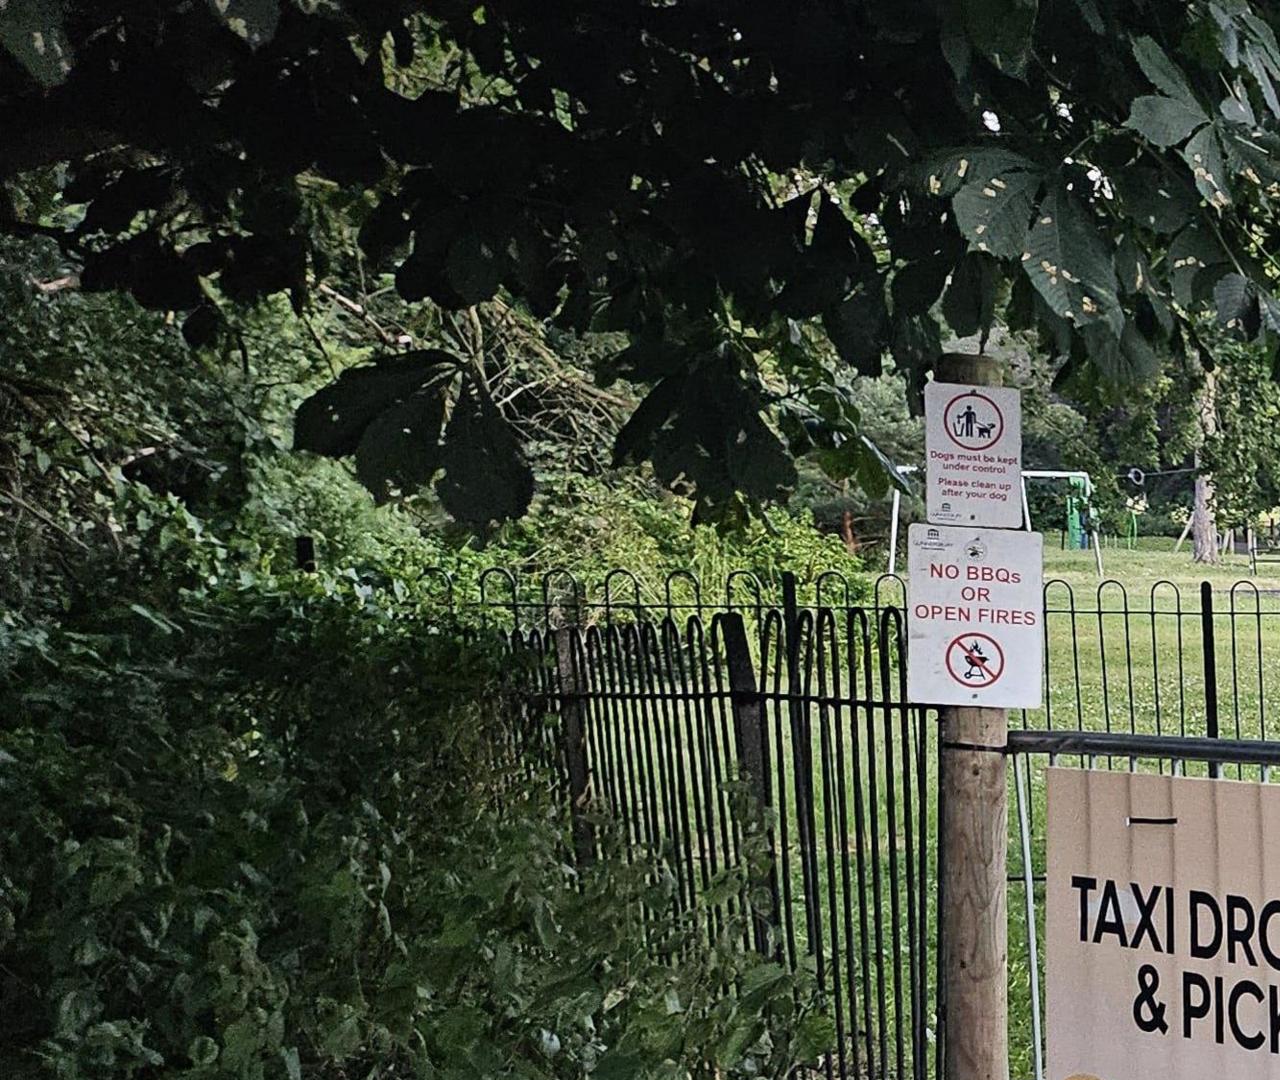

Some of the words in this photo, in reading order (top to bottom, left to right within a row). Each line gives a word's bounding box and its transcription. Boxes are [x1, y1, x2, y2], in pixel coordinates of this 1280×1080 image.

[930, 450, 955, 461] Dogs
[957, 453, 981, 461] must
[983, 455, 995, 463] be
[997, 455, 1018, 466] kept
[943, 463, 970, 471] under
[972, 464, 1006, 474] control
[938, 477, 970, 487] Please
[971, 480, 997, 489] clean
[999, 483, 1012, 491] up
[941, 488, 963, 497] after
[965, 490, 987, 499] your
[989, 491, 1008, 501] dog
[930, 563, 960, 580] NO
[966, 565, 1021, 584] BBQs
[961, 586, 991, 603] OR
[915, 604, 971, 622] OPEN
[978, 608, 1036, 627] FIRES
[1071, 875, 1175, 955] TAXI
[1132, 963, 1169, 1036] &
